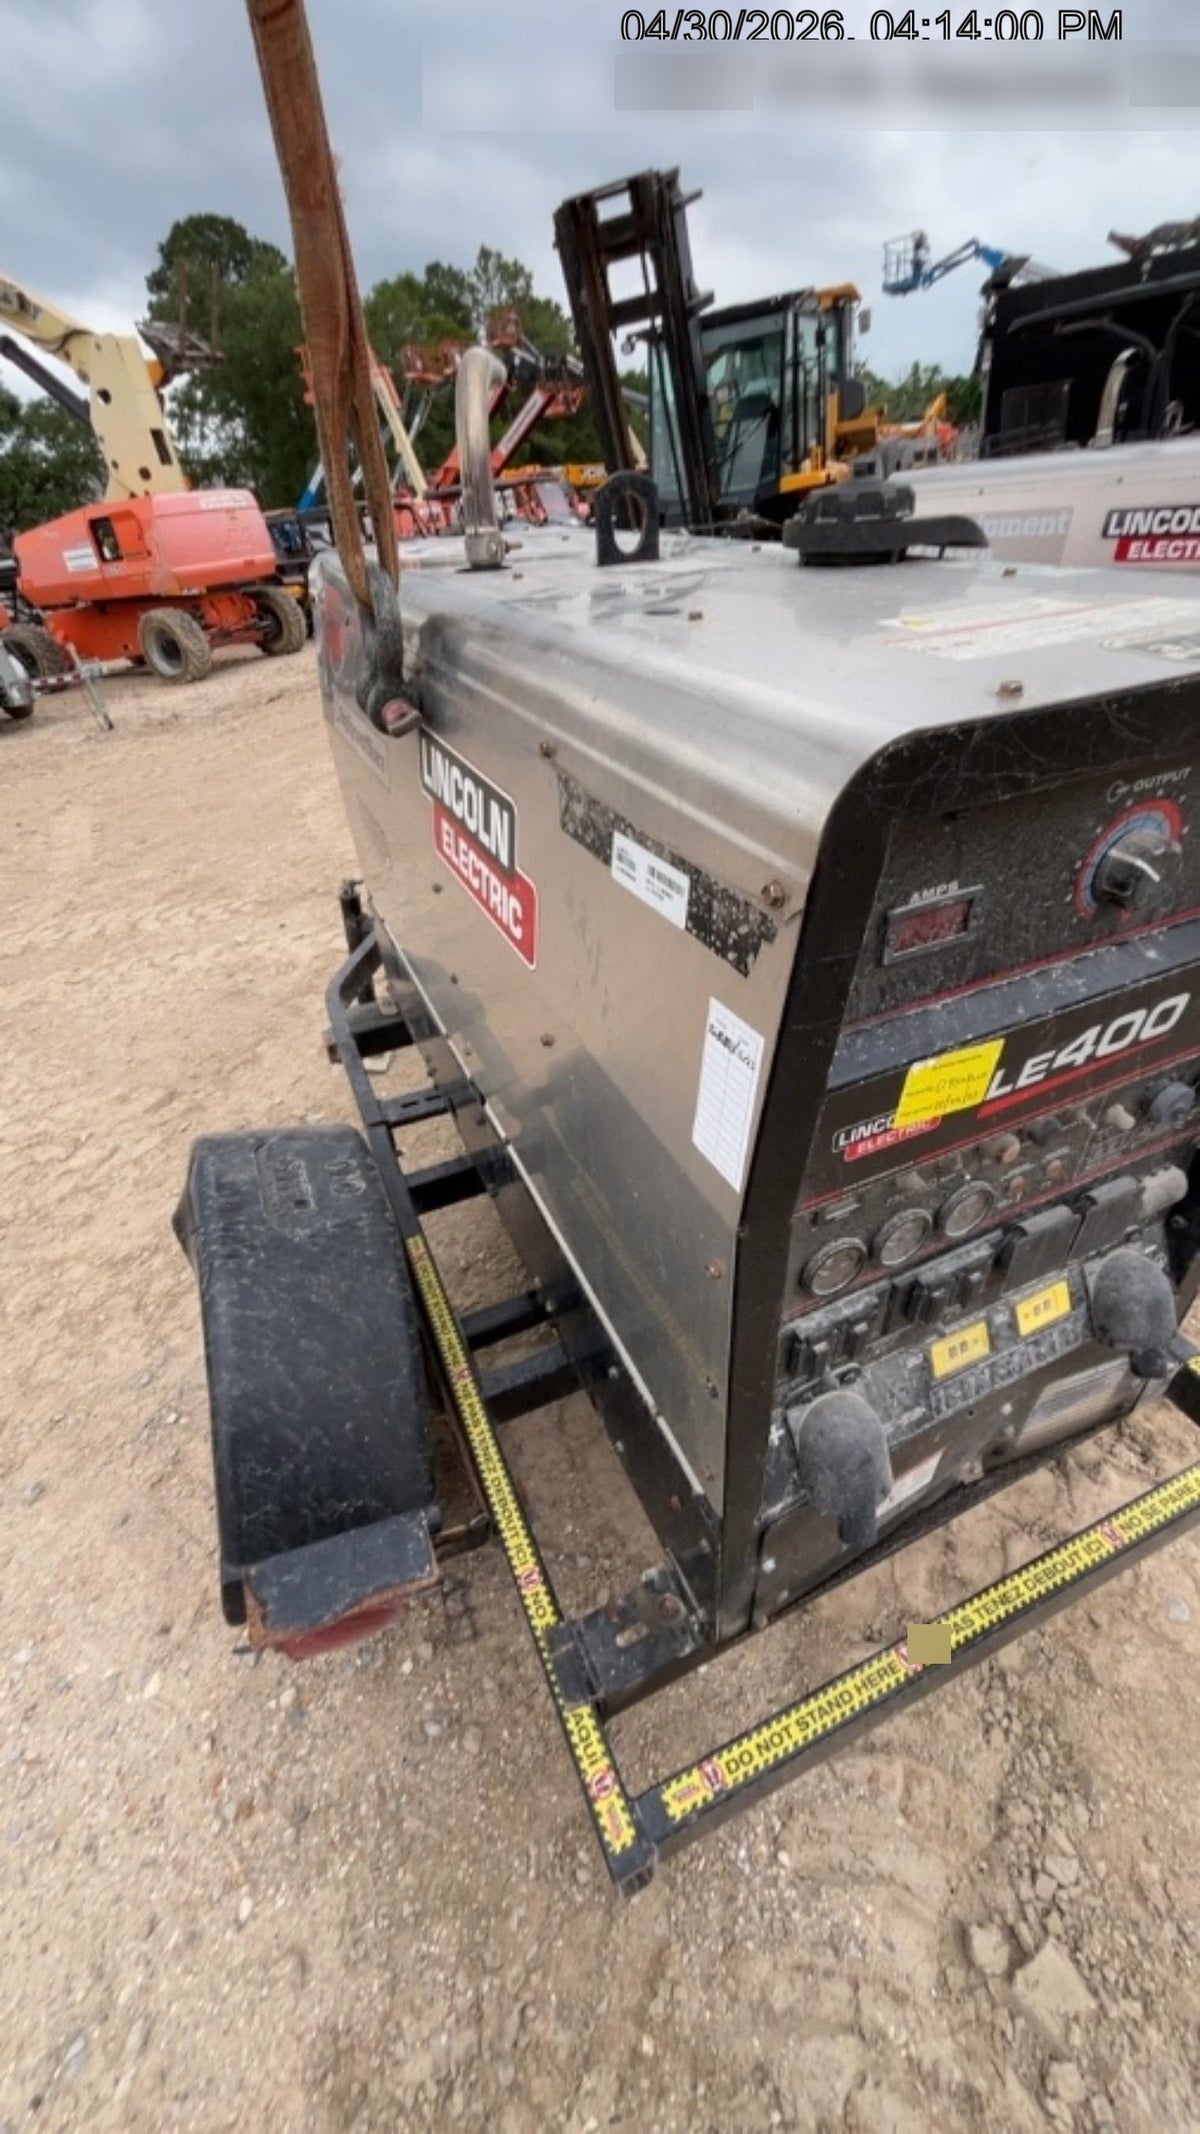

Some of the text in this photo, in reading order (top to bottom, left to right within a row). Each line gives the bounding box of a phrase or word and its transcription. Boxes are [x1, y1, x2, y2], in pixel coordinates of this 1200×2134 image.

[1127, 540, 1200, 560] ELECT
[422, 736, 508, 868] LINCOLN
[1133, 767, 1192, 792] OUTPUT
[441, 816, 522, 940] ELECTRIC
[910, 880, 959, 905] AMPS
[985, 993, 1191, 1100] LE400
[491, 1476, 519, 1538] DEBOUT
[513, 1542, 528, 1566] ICI
[1119, 1515, 1142, 1534] NO
[1140, 1503, 1160, 1517] SE
[973, 1588, 1024, 1620] TENEZ
[1023, 1552, 1083, 1590] DEBOUT
[1082, 1540, 1107, 1559] ICI
[530, 1590, 600, 1767] NO AQUI
[725, 1661, 899, 1774] DO NOT STAND HERE
